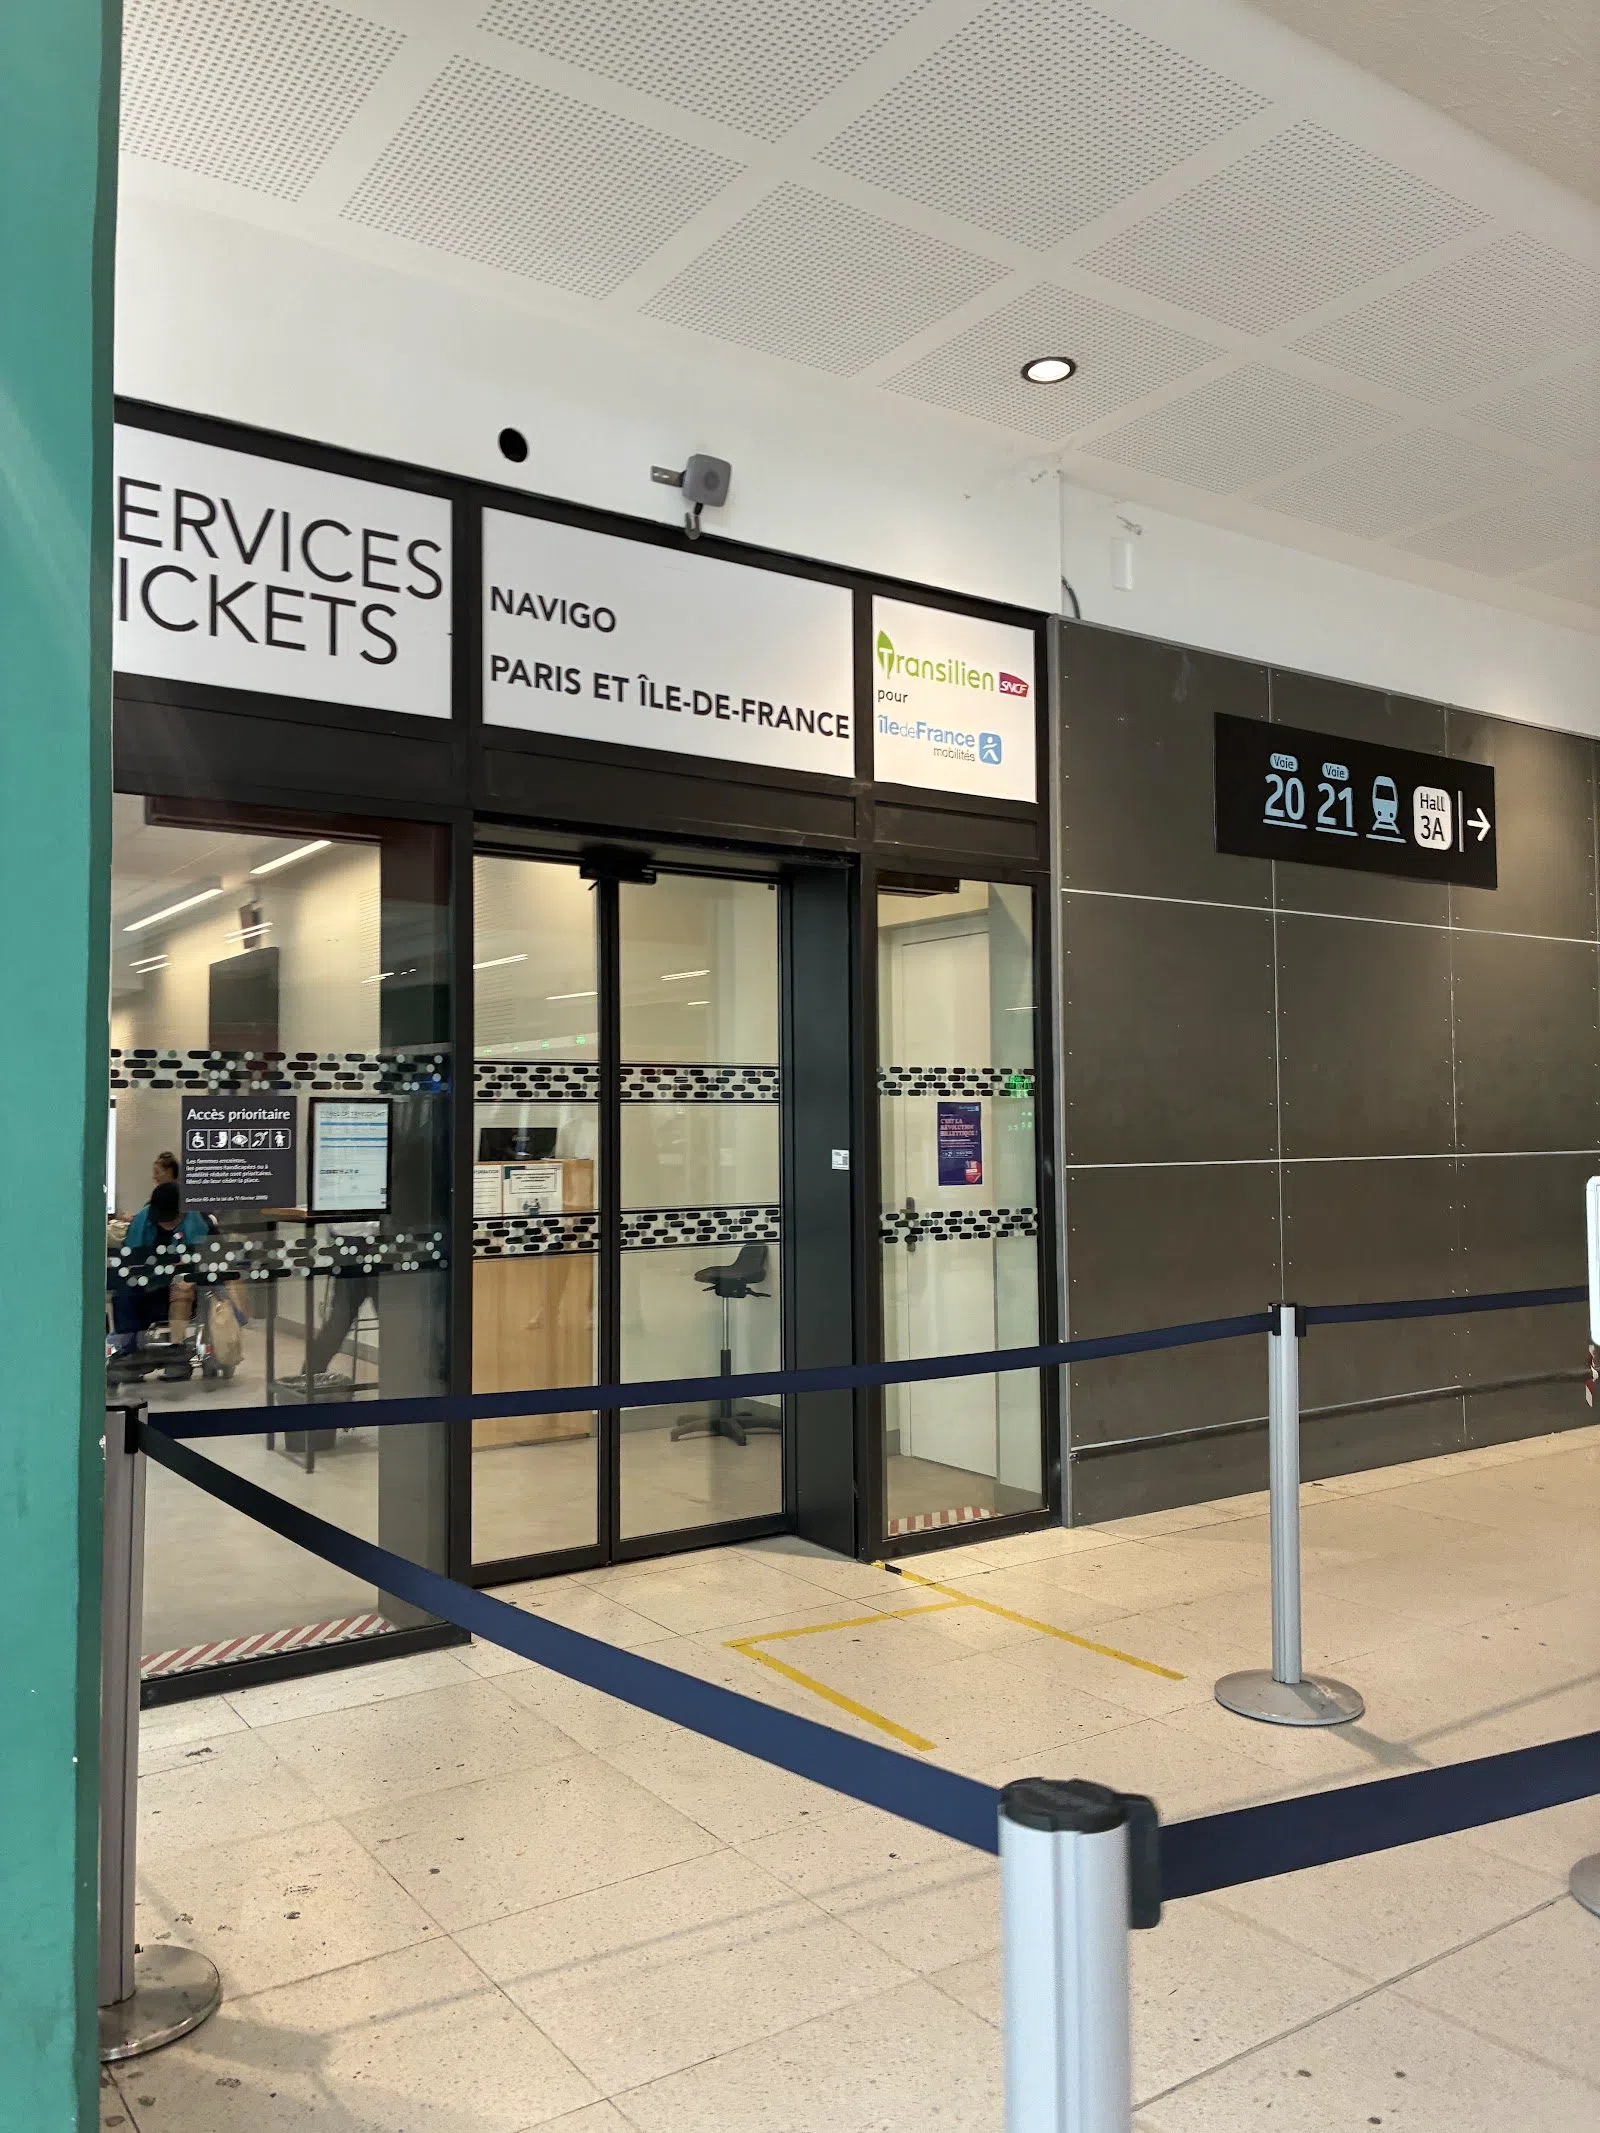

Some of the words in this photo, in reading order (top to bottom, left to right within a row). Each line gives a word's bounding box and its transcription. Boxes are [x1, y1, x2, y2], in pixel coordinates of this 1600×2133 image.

[118, 476, 443, 600] ERVICES
[119, 557, 397, 665] ICKETS
[490, 585, 617, 633] NAVIGO
[876, 631, 994, 691] Transilien
[1000, 679, 1029, 696] SNCF
[490, 654, 581, 695] PARIS
[593, 672, 630, 703] ET
[636, 673, 850, 739] ÎLE-DE-FRANCE
[877, 688, 908, 703] pour
[933, 746, 976, 762] mobilités
[1273, 755, 1295, 771] Voie
[1324, 764, 1346, 779] Voie
[1264, 773, 1305, 821] 20
[1317, 782, 1354, 828] 21
[1419, 792, 1446, 813] Hall
[1420, 815, 1445, 842] 3A
[187, 1108, 225, 1120] Accès
[228, 1108, 291, 1123] prioritaire
